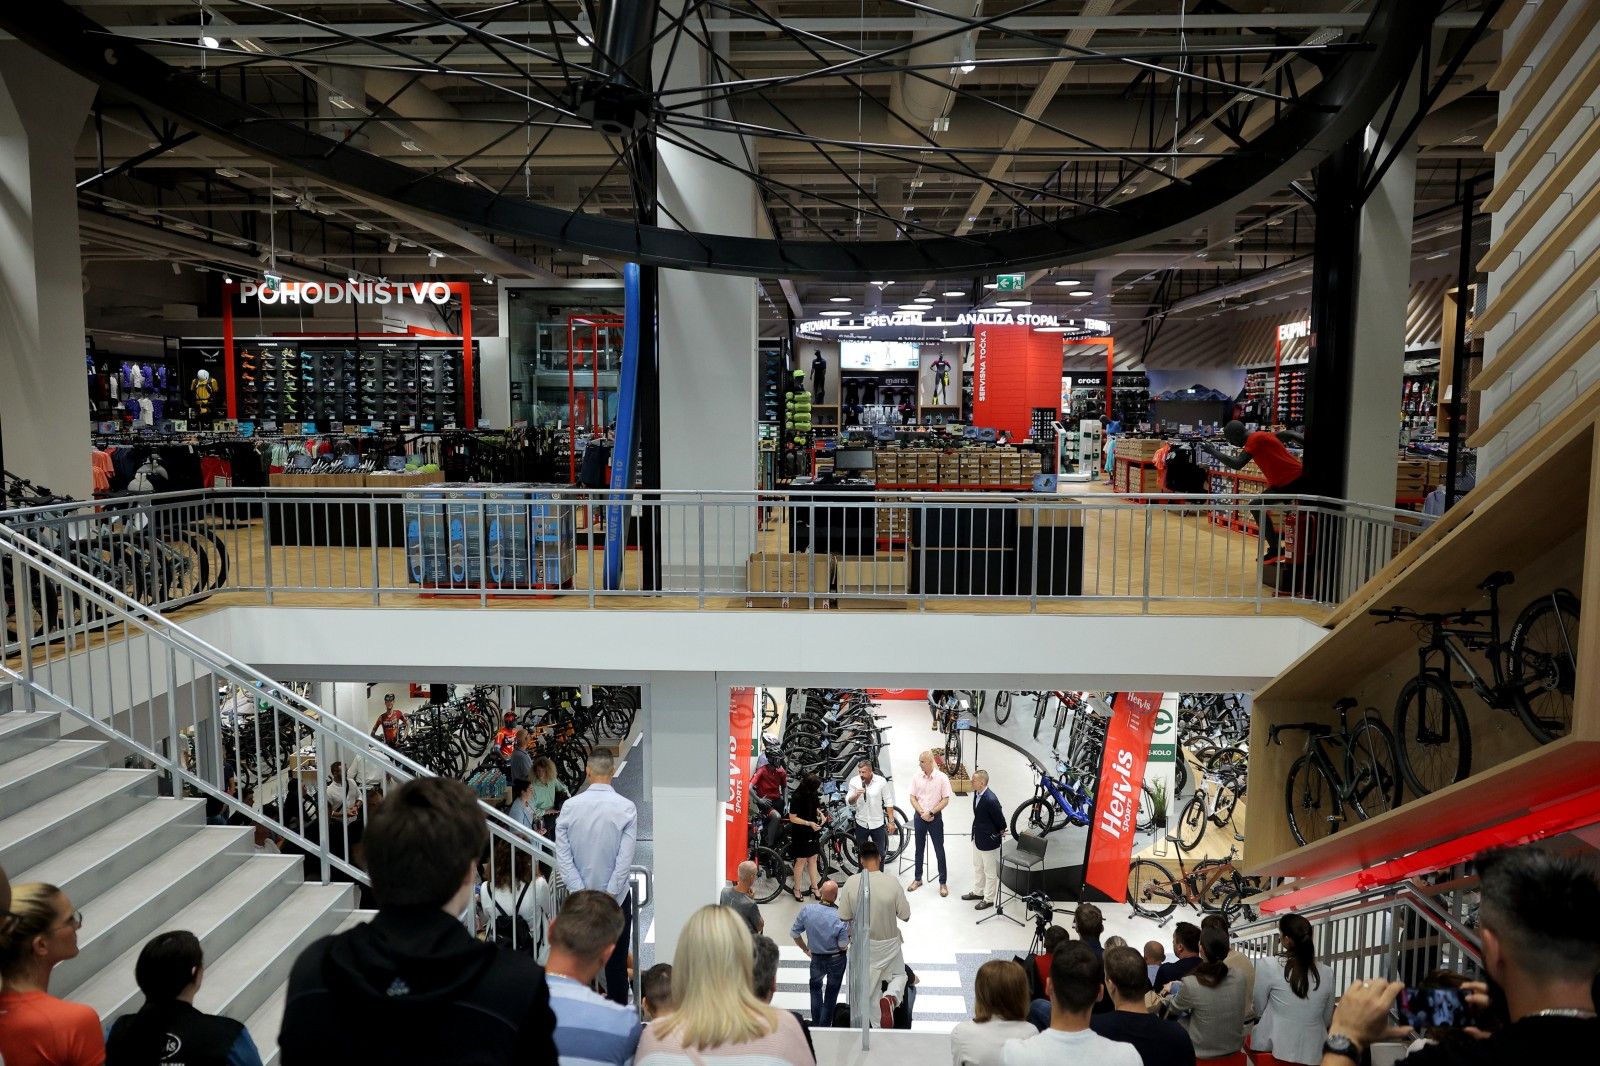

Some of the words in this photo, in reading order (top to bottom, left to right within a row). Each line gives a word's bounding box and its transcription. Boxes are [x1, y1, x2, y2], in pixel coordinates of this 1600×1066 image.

[240, 277, 451, 305] POHODNIŠTVO
[864, 314, 922, 327] PREVZEM
[957, 313, 1014, 325] ANALIZA
[1017, 314, 1060, 327] STOPAL
[978, 331, 986, 360] TOČKA
[885, 378, 908, 386] mares
[1127, 691, 1151, 710] Hervis
[1101, 749, 1133, 840] Hervis
